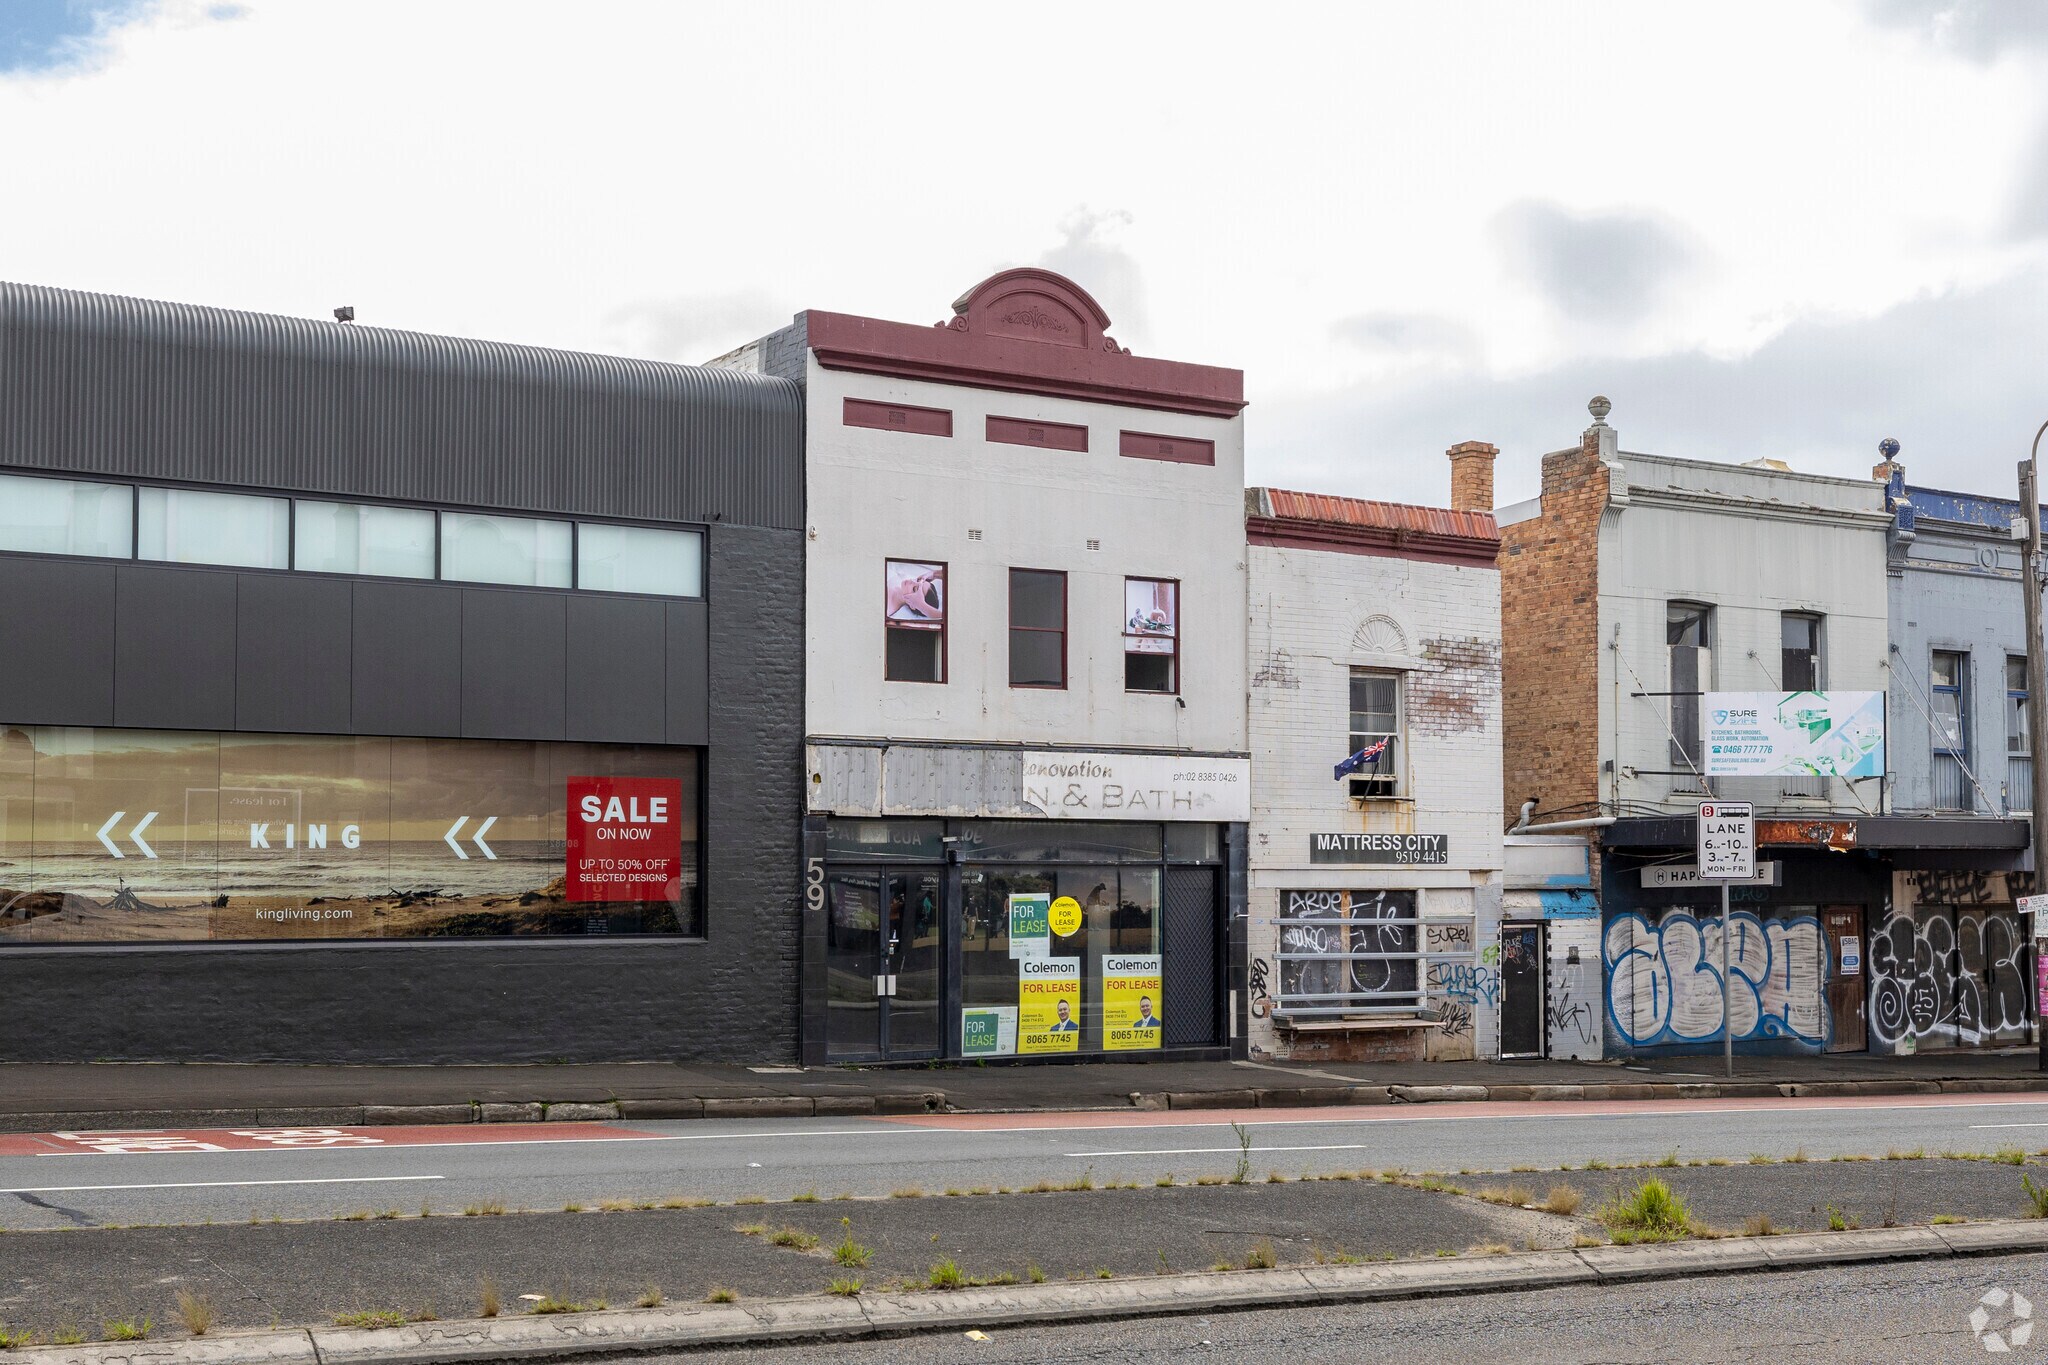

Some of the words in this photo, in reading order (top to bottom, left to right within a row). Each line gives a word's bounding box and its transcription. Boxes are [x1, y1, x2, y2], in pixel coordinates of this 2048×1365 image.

[1729, 709, 1757, 717] SURE
[1723, 745, 1742, 754] 0466
[1743, 745, 1757, 754] 777
[1758, 745, 1773, 754] 776
[1173, 772, 1196, 782] ph:02
[1198, 773, 1218, 782] 8385
[1219, 773, 1238, 783] 0426
[1063, 784, 1088, 808] &
[1102, 784, 1192, 810] BATH
[580, 795, 668, 823] SALE
[596, 828, 615, 840] ON
[620, 828, 651, 840] NOW
[1707, 823, 1745, 834] LANE
[250, 823, 360, 849] KING
[1317, 834, 1402, 851] MATTRESS
[1405, 835, 1440, 851] CITY
[1395, 851, 1420, 863] 9519
[1422, 852, 1447, 863] 4415
[579, 859, 596, 870] UP
[599, 859, 614, 870] TO
[617, 859, 642, 870] 50%
[579, 874, 626, 882] SELECTED
[628, 874, 668, 882] DESIGNS
[256, 908, 353, 921] kingliving.com
[1013, 905, 1034, 918] FOR
[1013, 920, 1046, 933] LEASE
[1024, 962, 1075, 973] Colemon
[1107, 959, 1157, 970] Colemon
[1023, 983, 1043, 993] FOR
[1046, 983, 1077, 992] LEASE
[1106, 981, 1126, 990] FOR
[1129, 980, 1159, 989] LEASE
[966, 1021, 985, 1033] FOR
[1026, 1034, 1048, 1044] 8065
[1050, 1034, 1071, 1043] 7745
[1111, 1031, 1131, 1040] 8065
[1134, 1030, 1154, 1039] 7745
[965, 1035, 995, 1047] LEASE
